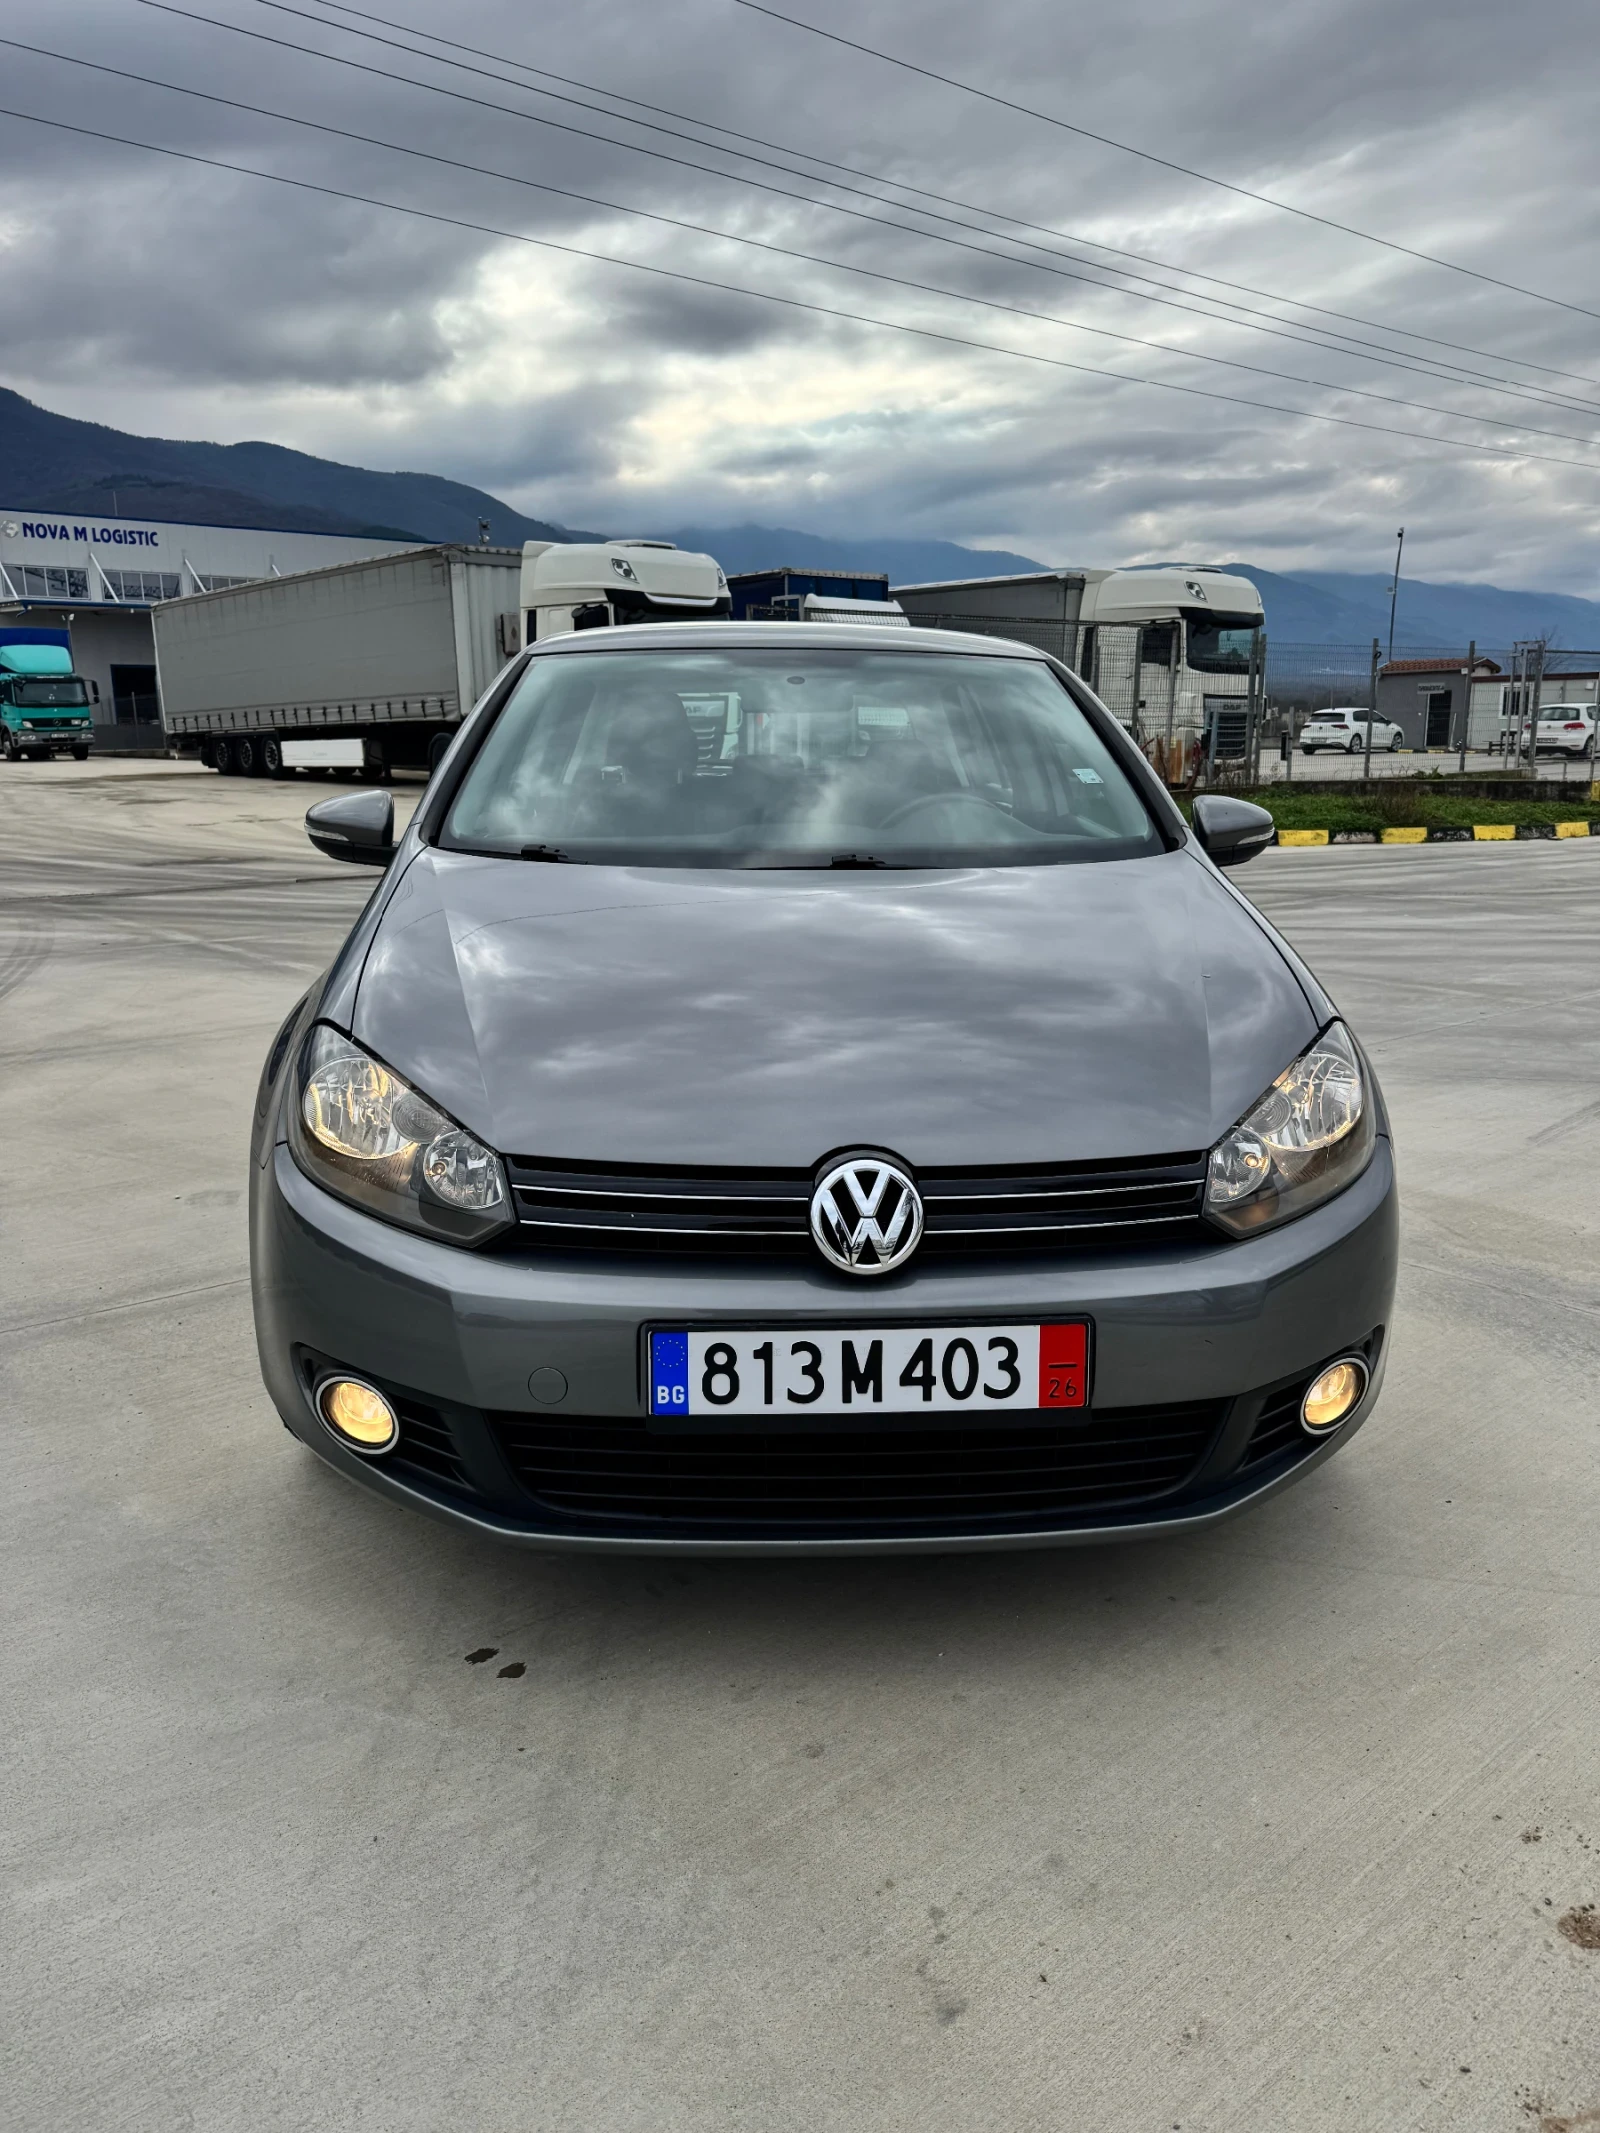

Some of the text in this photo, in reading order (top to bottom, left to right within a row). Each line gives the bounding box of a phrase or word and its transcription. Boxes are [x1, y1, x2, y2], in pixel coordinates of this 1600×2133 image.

[22, 522, 159, 546] NOVA M LOGISTIC
[656, 1385, 686, 1404] BG
[1047, 1377, 1078, 1399] 26
